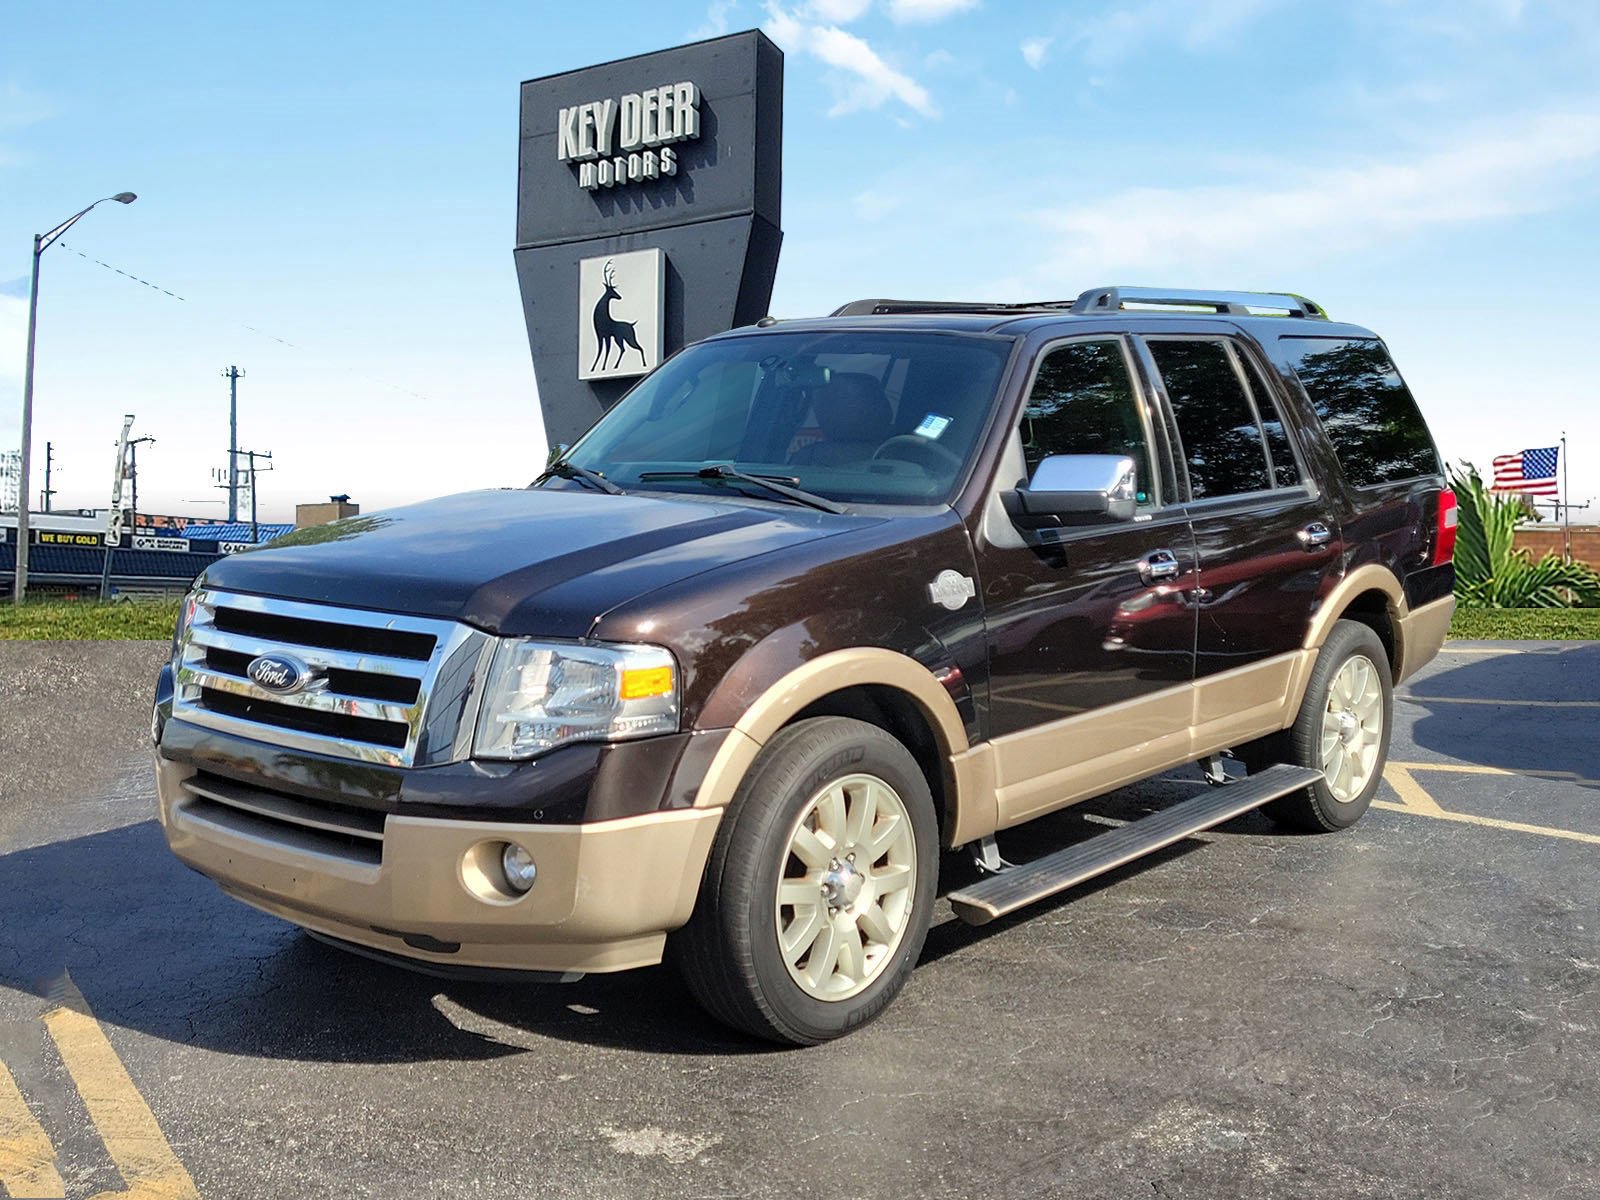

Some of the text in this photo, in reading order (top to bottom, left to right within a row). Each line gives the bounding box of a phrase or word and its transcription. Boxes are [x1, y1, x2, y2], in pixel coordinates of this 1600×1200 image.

[557, 80, 701, 164] KEY DEER
[578, 146, 678, 190] MOTORS
[41, 533, 97, 545] WE BUY GOLD
[254, 659, 289, 686] Ford
